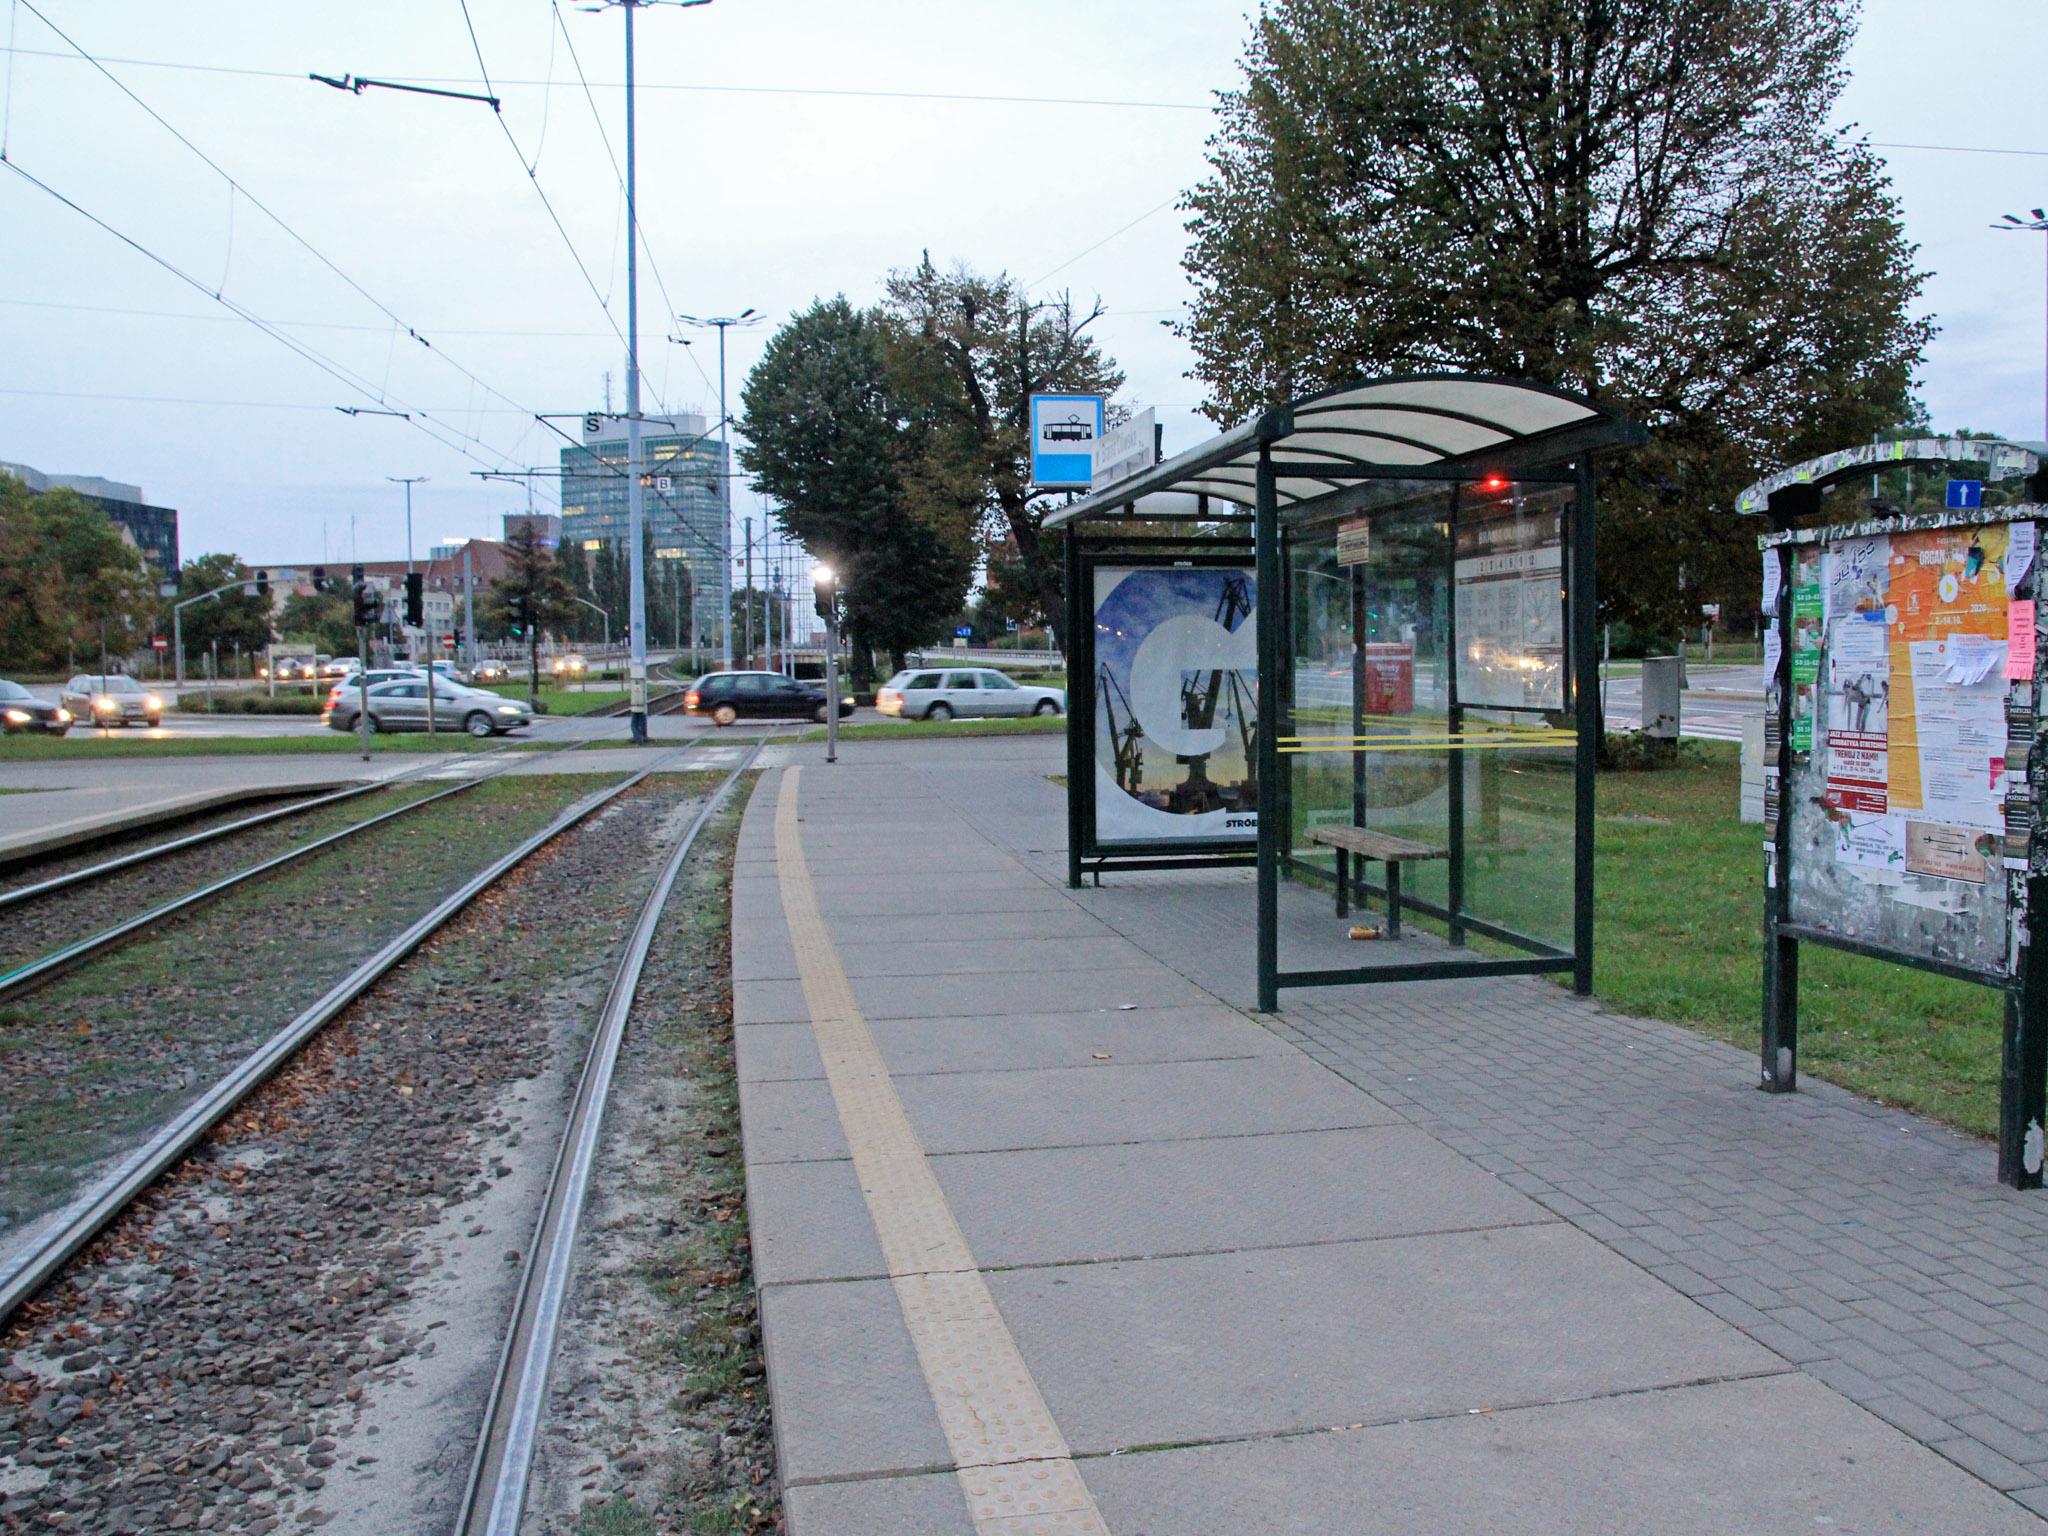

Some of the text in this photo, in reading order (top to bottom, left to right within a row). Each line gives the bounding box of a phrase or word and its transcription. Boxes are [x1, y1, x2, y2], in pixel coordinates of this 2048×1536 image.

[586, 418, 600, 432] S
[661, 479, 668, 489] B
[1226, 818, 1258, 828] STRÖE
